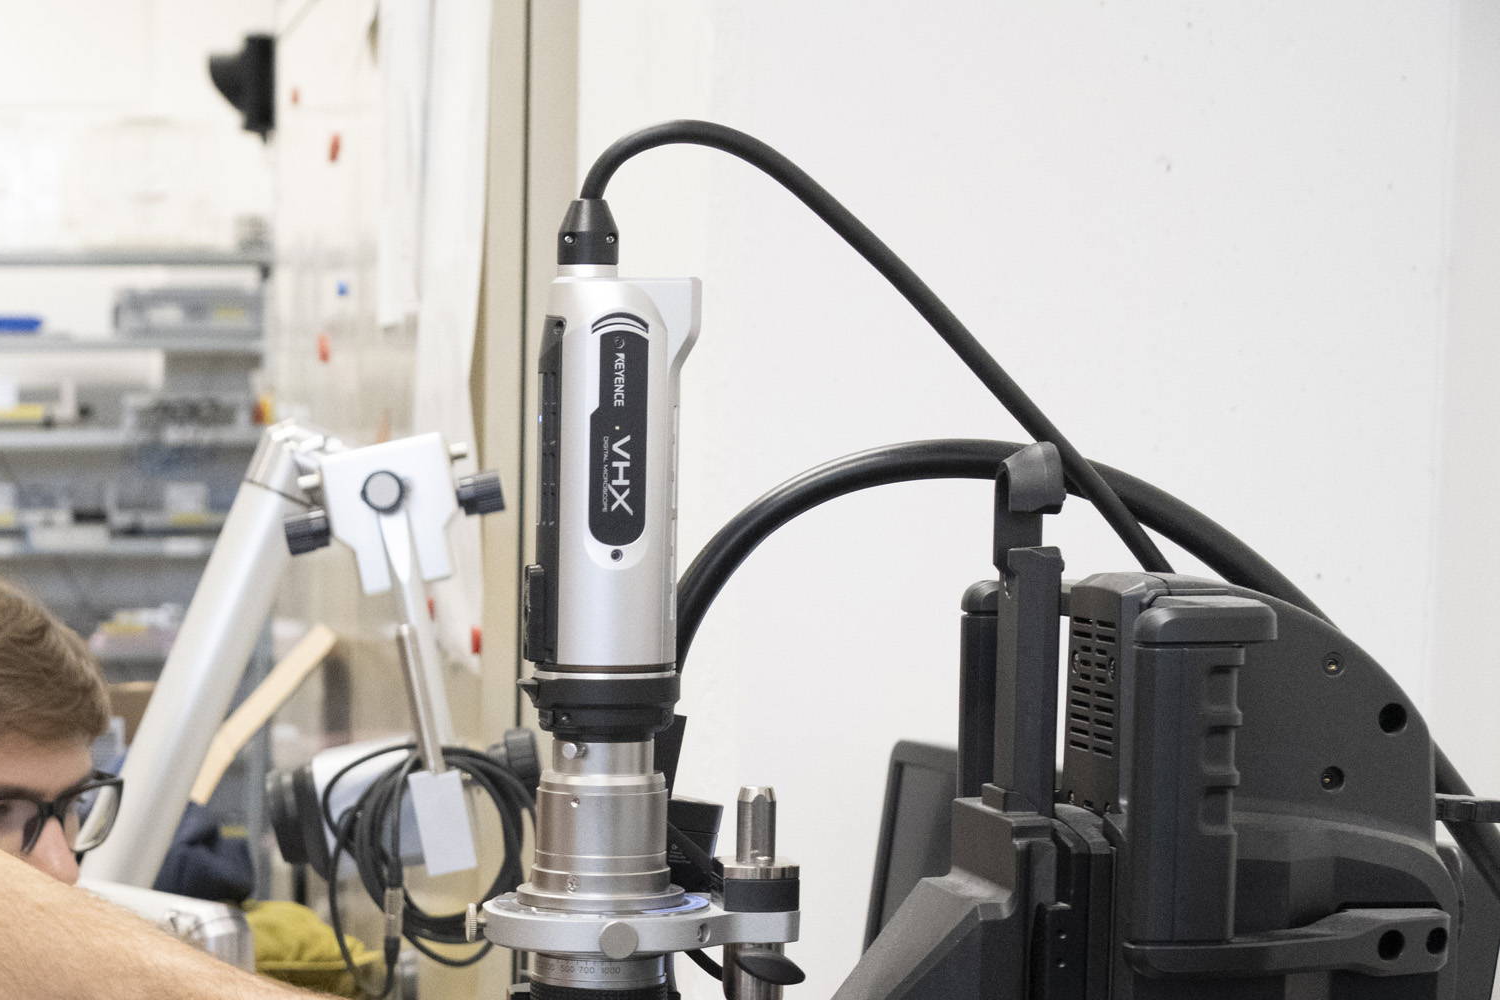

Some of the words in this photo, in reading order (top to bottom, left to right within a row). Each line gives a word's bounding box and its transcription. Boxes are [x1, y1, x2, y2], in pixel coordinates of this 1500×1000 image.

[613, 352, 626, 407] KEYENCE
[608, 434, 634, 516] VHX
[560, 964, 575, 973] 500
[579, 966, 596, 974] 700
